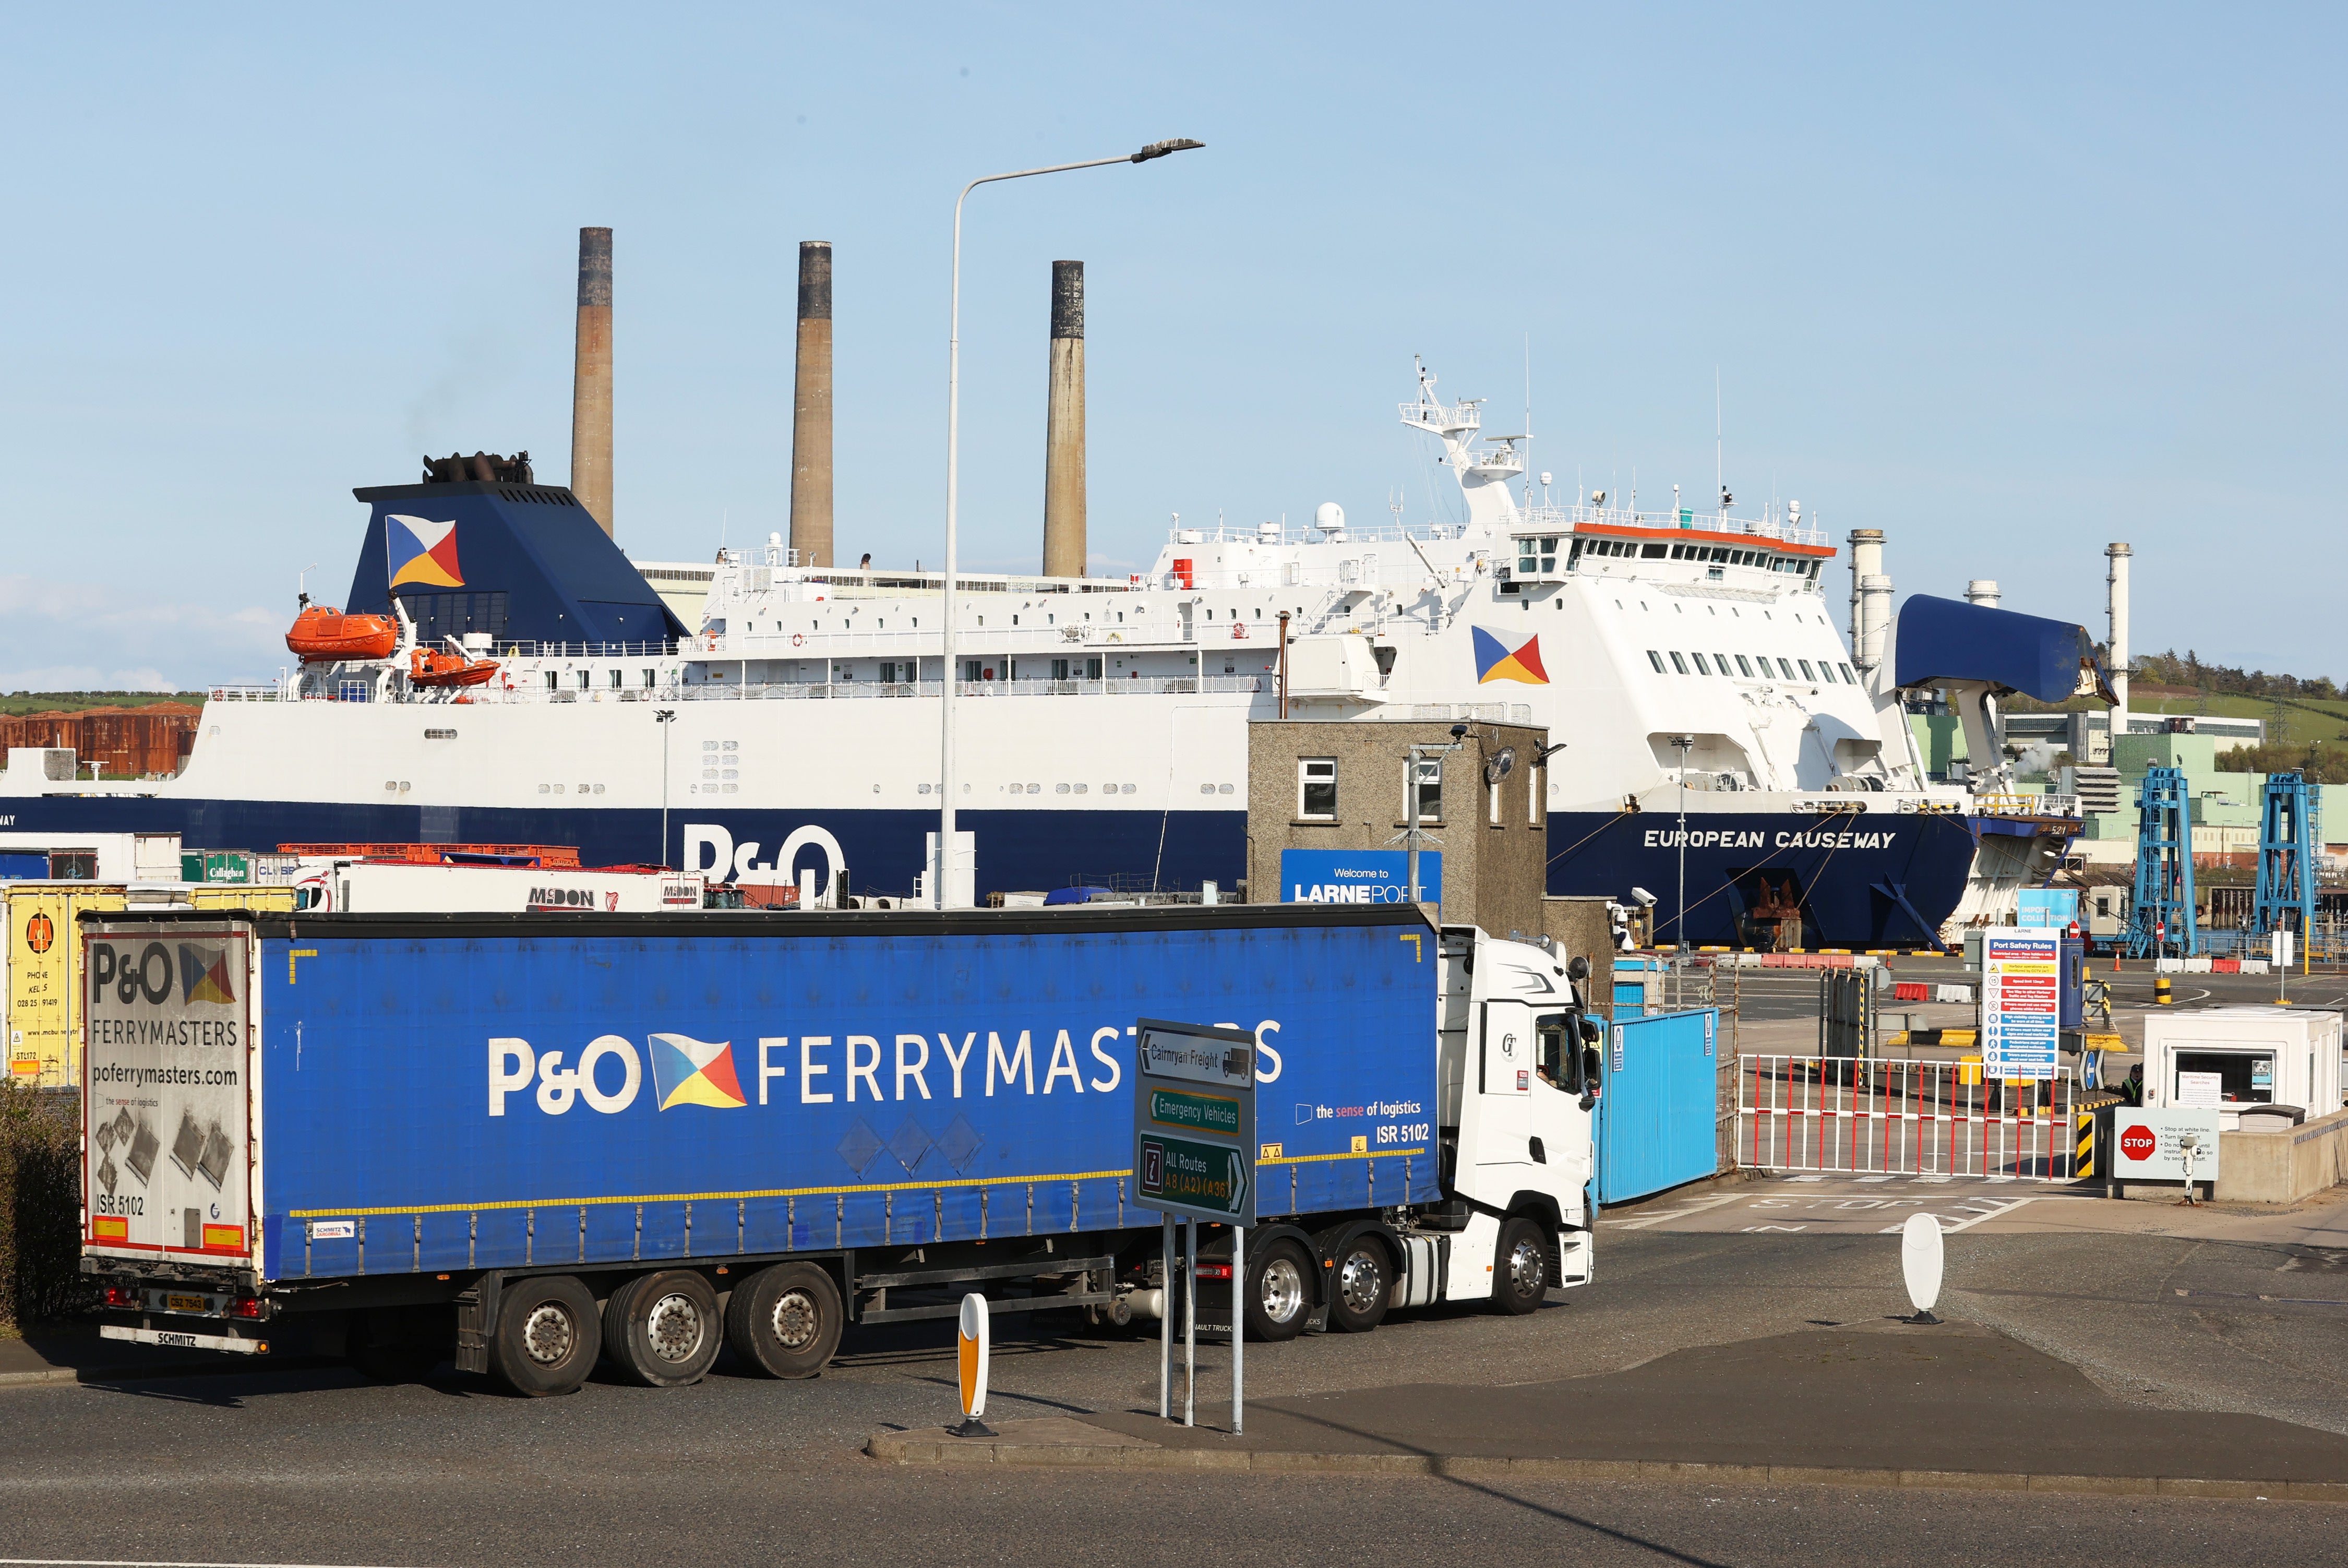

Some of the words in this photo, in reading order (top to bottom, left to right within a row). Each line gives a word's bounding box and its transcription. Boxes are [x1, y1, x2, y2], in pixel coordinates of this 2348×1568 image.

[1644, 830, 1765, 847] EUROPEAN
[1775, 832, 1896, 848] CAUSEWAY
[684, 824, 846, 899] P&O
[209, 867, 244, 879] Callaghan
[1334, 868, 1375, 879] Welcome
[1379, 868, 1388, 879] to
[93, 942, 173, 1005] P&O
[28, 984, 47, 994] KELS
[93, 1020, 237, 1046] FERRYMASTERS
[1151, 1044, 1188, 1066] Cairnryan
[1191, 1049, 1218, 1069] Freight
[93, 1062, 237, 1087] poferrymasters.com
[488, 1035, 641, 1117] P&O
[758, 1020, 1283, 1105] FERRYMASS
[106, 1097, 114, 1105] the
[131, 1097, 137, 1106] of
[137, 1098, 158, 1108] logistics
[1160, 1098, 1201, 1122] Emergency
[1204, 1105, 1236, 1124] Vehicles
[1316, 1105, 1333, 1118] the
[1336, 1106, 1364, 1117] sense
[1367, 1102, 1377, 1116] of
[1380, 1100, 1421, 1118] logistics
[1377, 1126, 1398, 1144] ISR
[1401, 1123, 1429, 1143] 5102
[2124, 1138, 2153, 1147] STOP
[1166, 1152, 1176, 1168] All
[1179, 1156, 1206, 1173] Routes
[1165, 1172, 1177, 1188] A8
[1180, 1174, 1200, 1194] (A2)
[1203, 1180, 1231, 1200] (A36)
[97, 1194, 115, 1215] ISR
[118, 1196, 144, 1216] 5102
[1749, 1199, 1924, 1210] STOP
[158, 1332, 196, 1346] SCHMITZ
